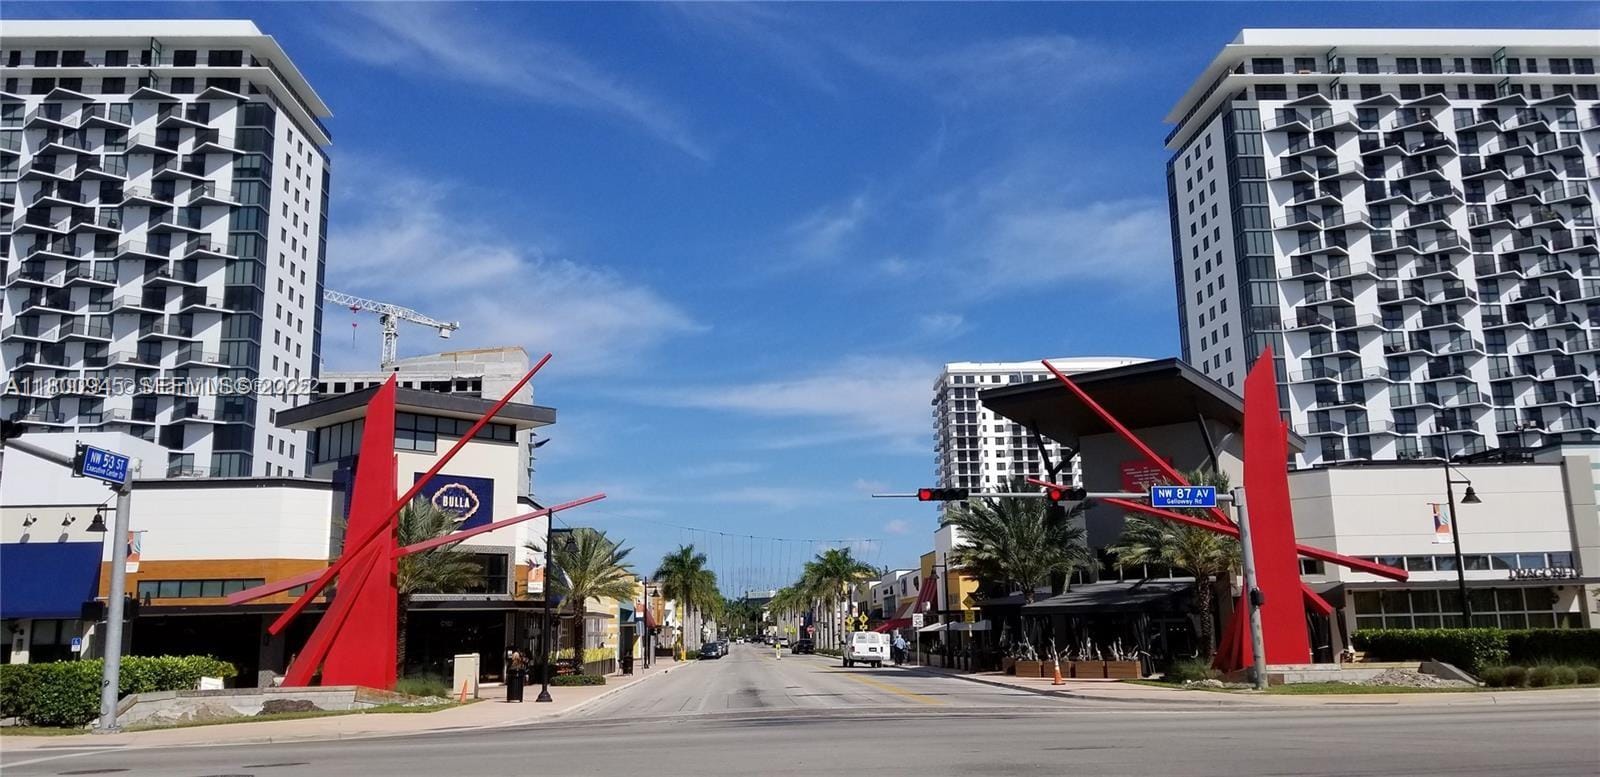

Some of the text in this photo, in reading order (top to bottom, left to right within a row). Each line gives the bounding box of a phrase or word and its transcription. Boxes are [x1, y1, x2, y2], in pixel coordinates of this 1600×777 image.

[90, 451, 125, 470] NW 53 ST
[1158, 488, 1209, 499] NW 87 AV
[442, 495, 470, 508] BULLA
